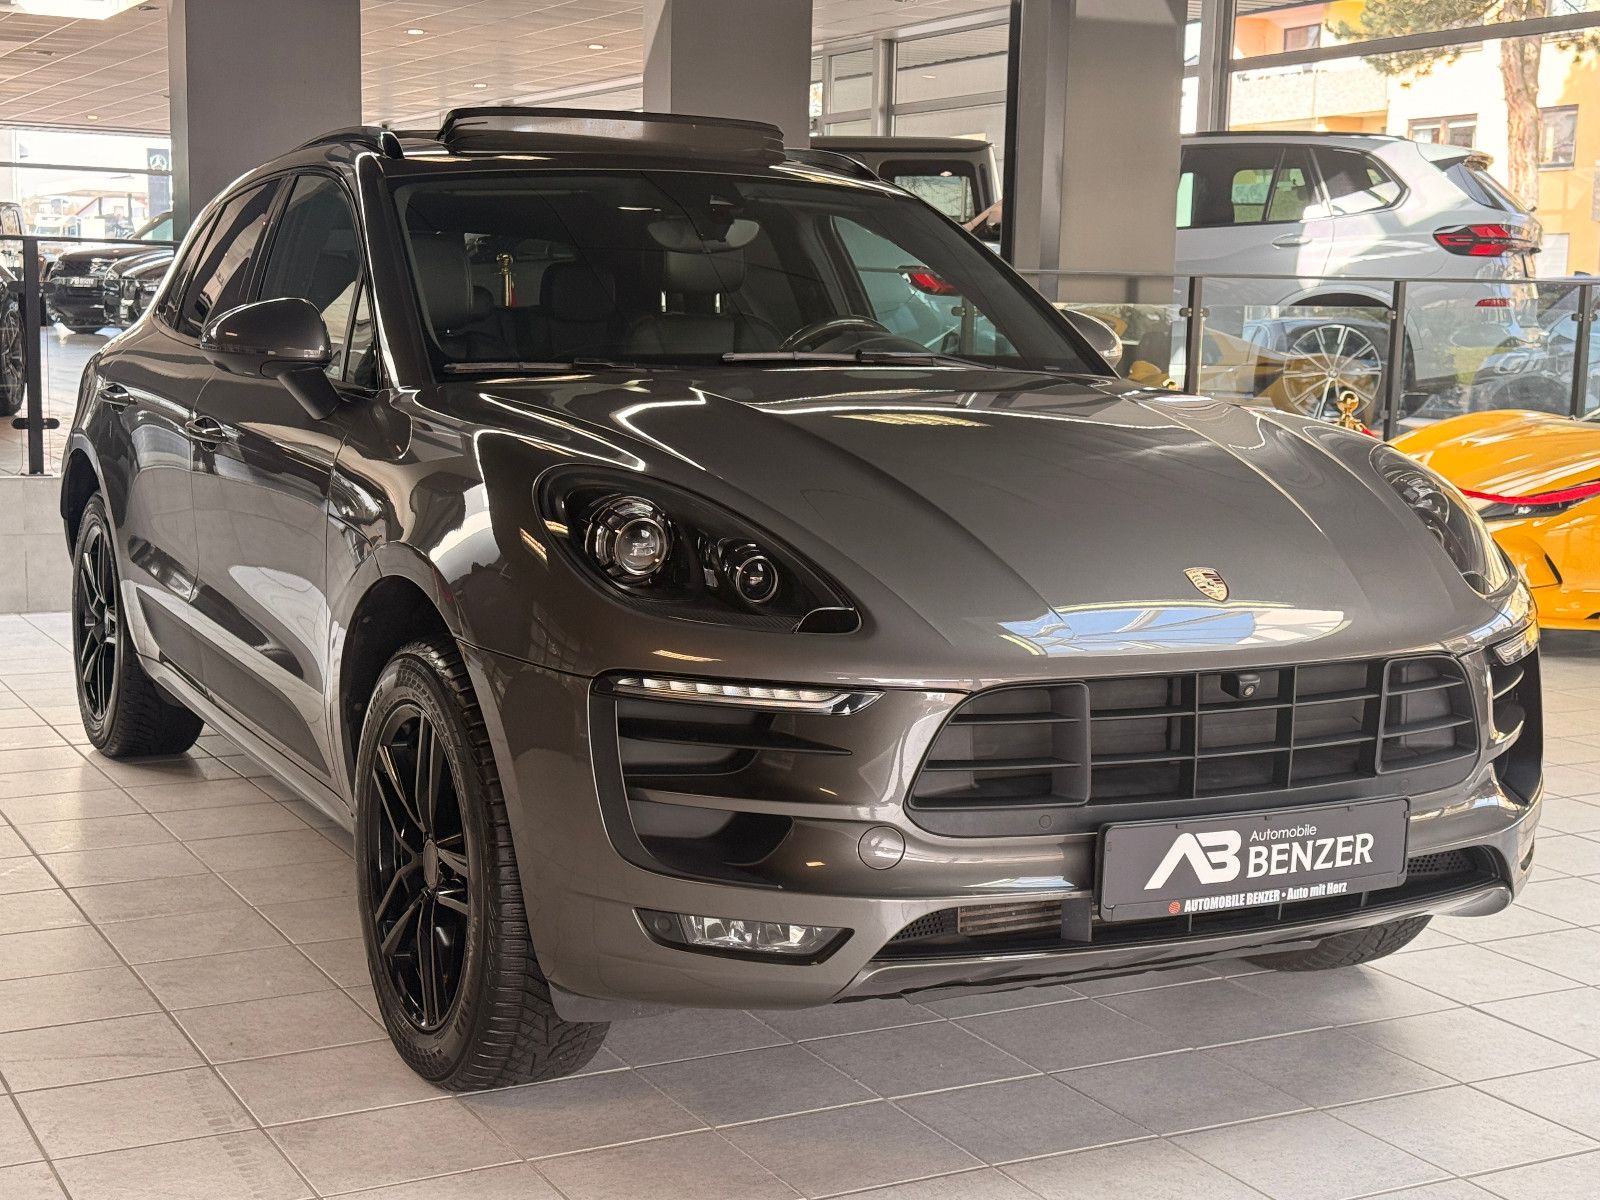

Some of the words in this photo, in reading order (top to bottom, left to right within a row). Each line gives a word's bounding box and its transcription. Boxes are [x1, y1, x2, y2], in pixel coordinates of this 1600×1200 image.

[1250, 824, 1317, 842] Automobile
[1246, 833, 1375, 879] BENZER
[1184, 893, 1246, 914] AUTOMOBILE
[1246, 889, 1281, 903] BENZER
[1286, 887, 1309, 901] Auto
[1309, 885, 1327, 898] mit
[1326, 882, 1348, 896] Herz
